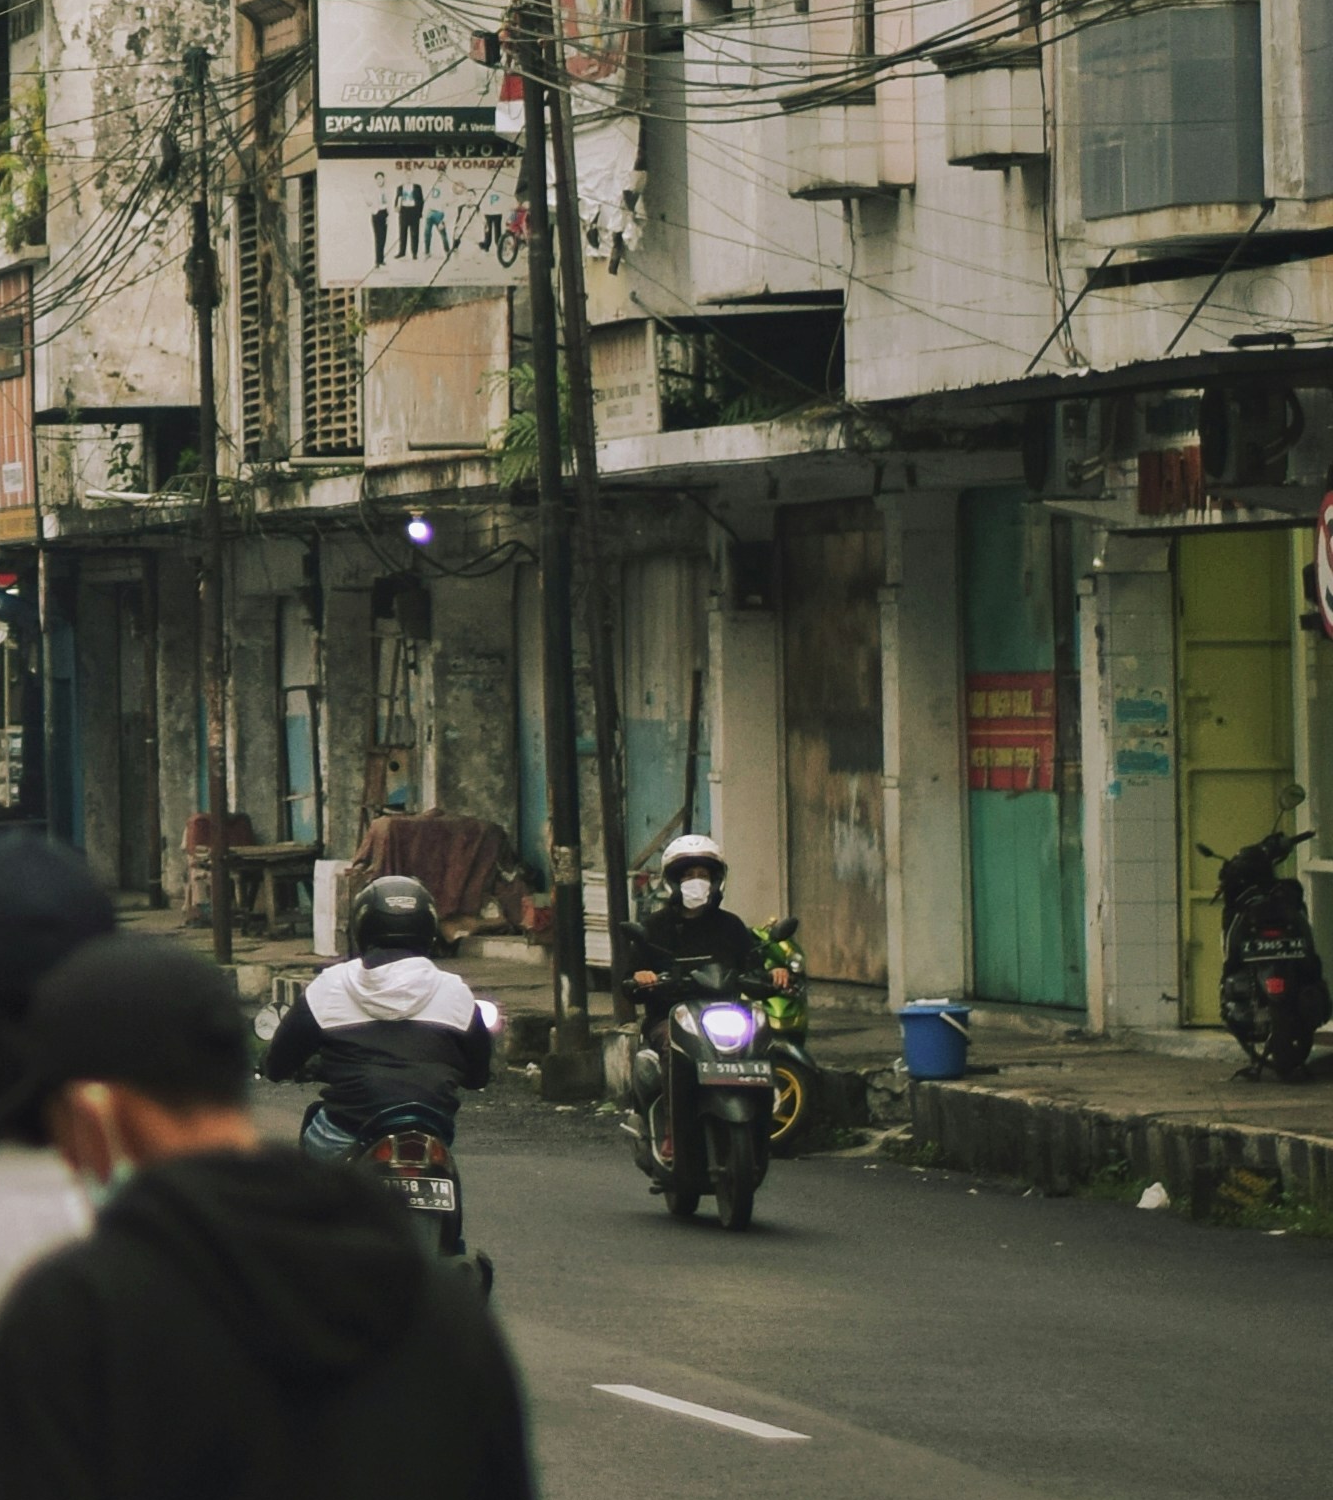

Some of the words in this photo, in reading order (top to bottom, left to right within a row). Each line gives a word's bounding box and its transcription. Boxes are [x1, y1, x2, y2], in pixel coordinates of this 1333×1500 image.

[362, 67, 423, 87] Xtra
[366, 115, 401, 132] JAYA
[404, 115, 455, 133] MOTOR
